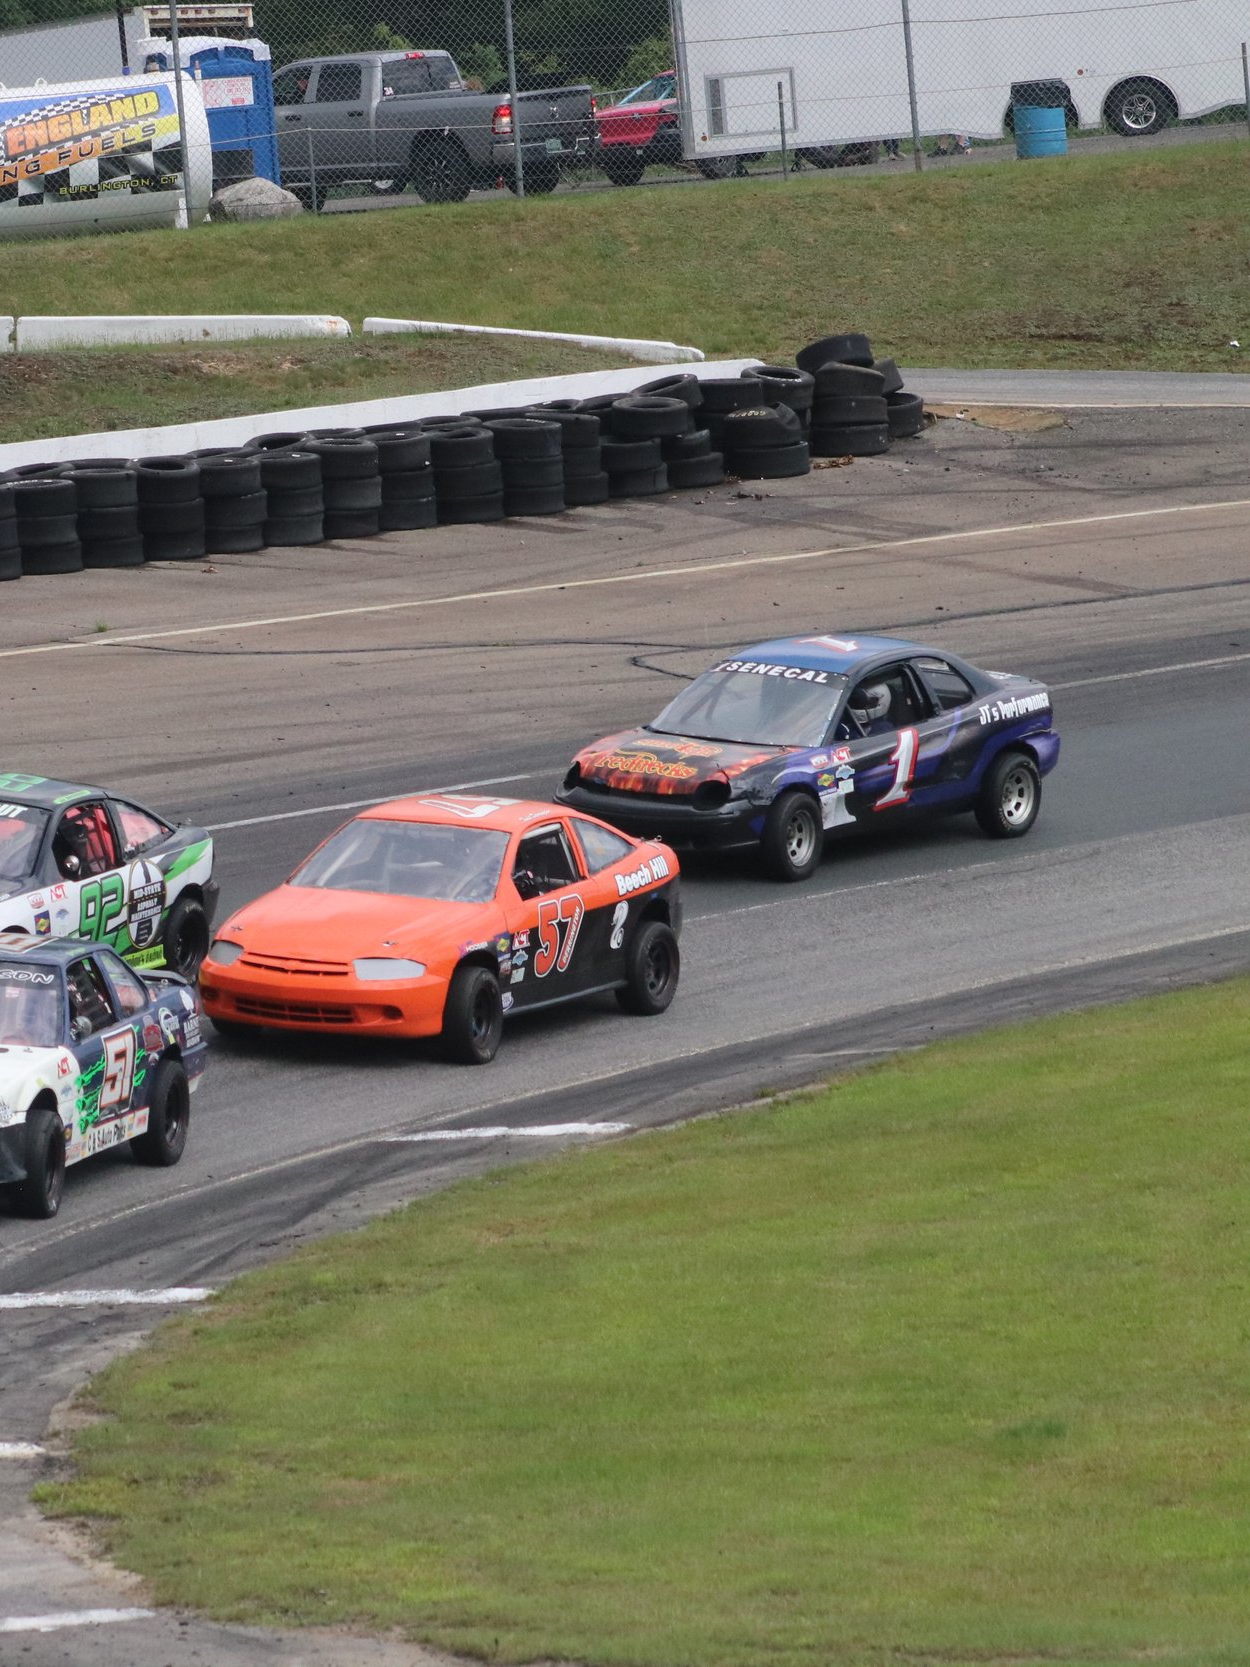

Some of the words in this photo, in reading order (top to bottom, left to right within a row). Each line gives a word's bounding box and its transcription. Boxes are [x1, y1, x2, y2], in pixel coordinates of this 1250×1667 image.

[7, 91, 160, 156] ENGLAND
[59, 124, 156, 164] FUELS
[59, 178, 154, 195] BURLINGTON,
[160, 175, 177, 185] CT
[726, 661, 828, 684] SENECAL
[873, 727, 919, 812] 1
[614, 863, 652, 896] Beech
[648, 855, 670, 880] Hill
[79, 872, 124, 950] 92
[534, 893, 585, 978] 57
[100, 1031, 135, 1108] 51
